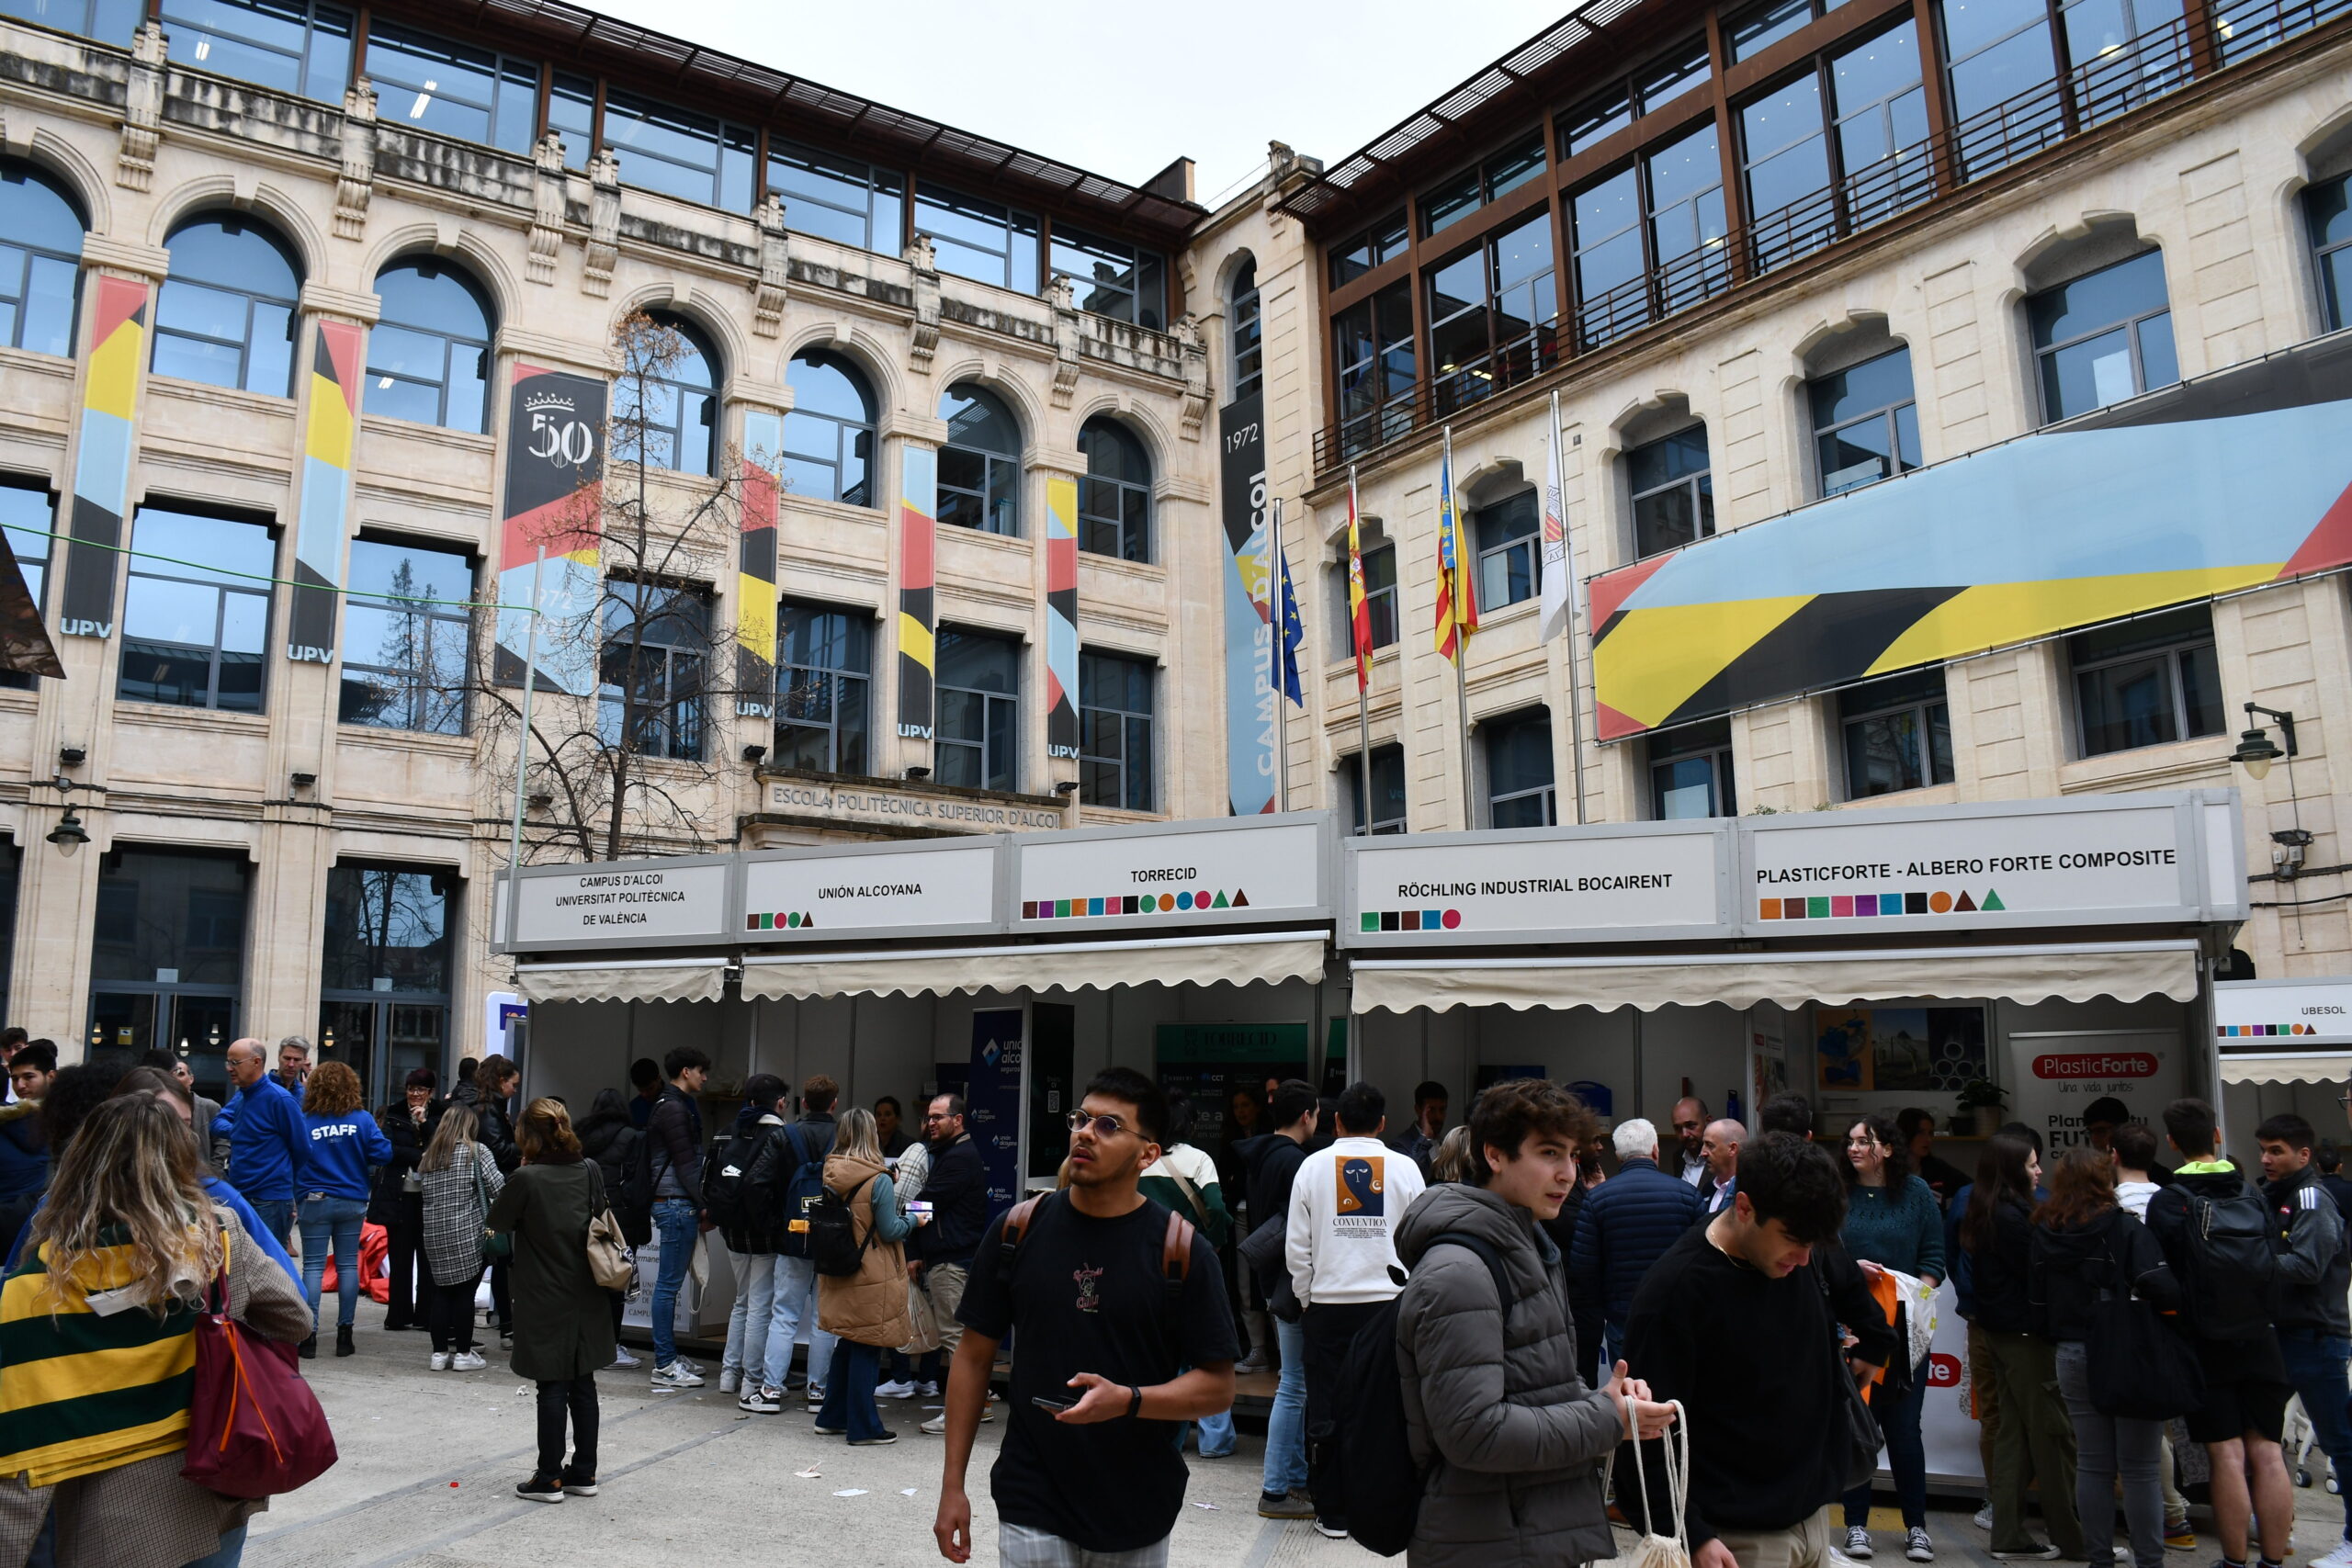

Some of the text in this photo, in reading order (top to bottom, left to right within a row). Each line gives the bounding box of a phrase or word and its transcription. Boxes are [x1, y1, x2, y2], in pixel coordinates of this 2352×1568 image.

[528, 413, 593, 464] 50
[1227, 423, 1259, 454] 1972
[60, 617, 112, 638] UPV
[287, 644, 334, 663] UPV
[1254, 623, 1274, 776] CAMPUS
[736, 702, 773, 718] UPV
[898, 723, 933, 739] UPV
[1048, 744, 1079, 760] UPV
[774, 786, 832, 808] ESCOLA
[837, 793, 933, 818] POLITÈCNICA
[938, 804, 1004, 825] SUPERIOR
[1130, 867, 1197, 883] TORRECID
[1757, 863, 1891, 885] PLASTICFORTE
[1906, 858, 1984, 877] ALBERO
[1990, 854, 2052, 873] FORTE
[2058, 849, 2177, 869] COMPOSITE
[580, 874, 663, 888] CAMPUS D'ALCOI
[1397, 874, 1673, 897] RÖCHLING INDUSTRIAL BOCAIRENT
[556, 889, 685, 907] UNIVERSITAT POLITÈCNICA
[818, 883, 922, 899] UNIÓN ALCOYANA
[582, 911, 647, 925] DE VALÈNCIA
[2301, 1006, 2346, 1015] UBESOL
[2043, 1056, 2149, 1074] PlasticForte
[2083, 1080, 2102, 1093] vida
[2106, 1080, 2134, 1095] juntos
[311, 1123, 357, 1140] STAFF
[1332, 1217, 1387, 1227] CONVENTION
[628, 1308, 651, 1317] CAMPU
